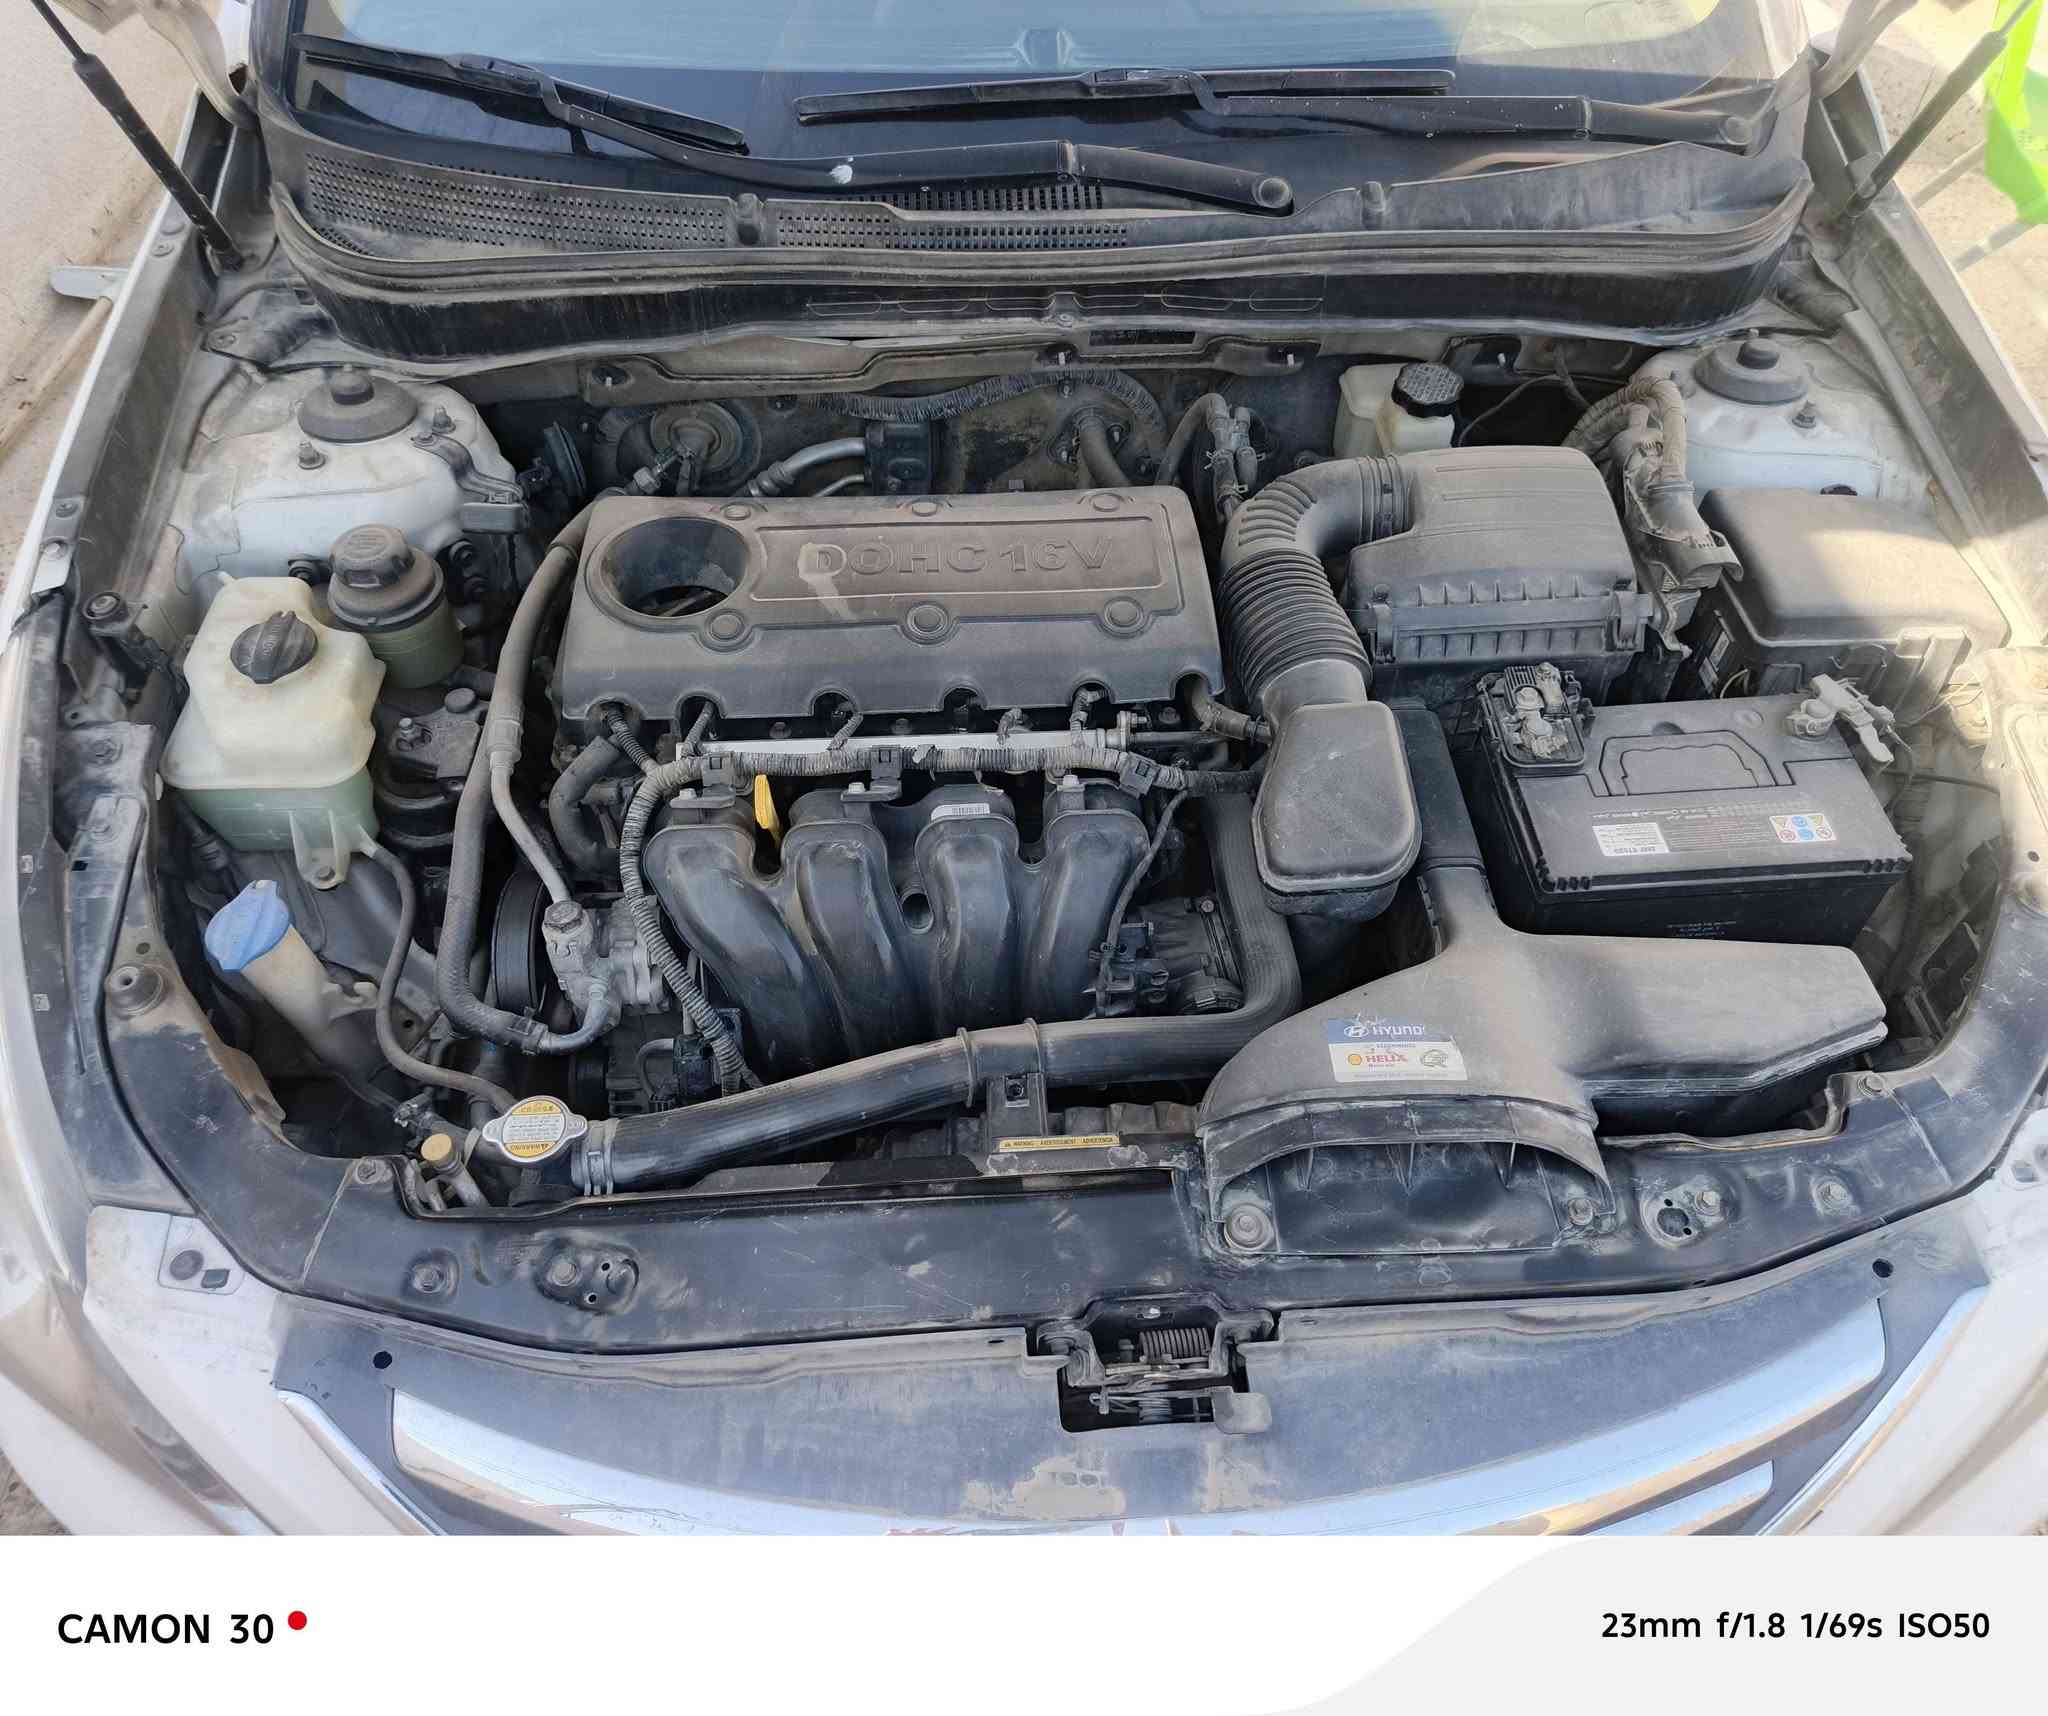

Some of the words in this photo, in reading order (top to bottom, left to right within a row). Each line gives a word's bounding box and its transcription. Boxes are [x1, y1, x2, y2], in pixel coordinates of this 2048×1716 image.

[798, 540, 988, 577] DOHC
[1000, 536, 1114, 573] 16V
[1372, 1024, 1425, 1036] HYUND
[1365, 1053, 1408, 1063] HELIX
